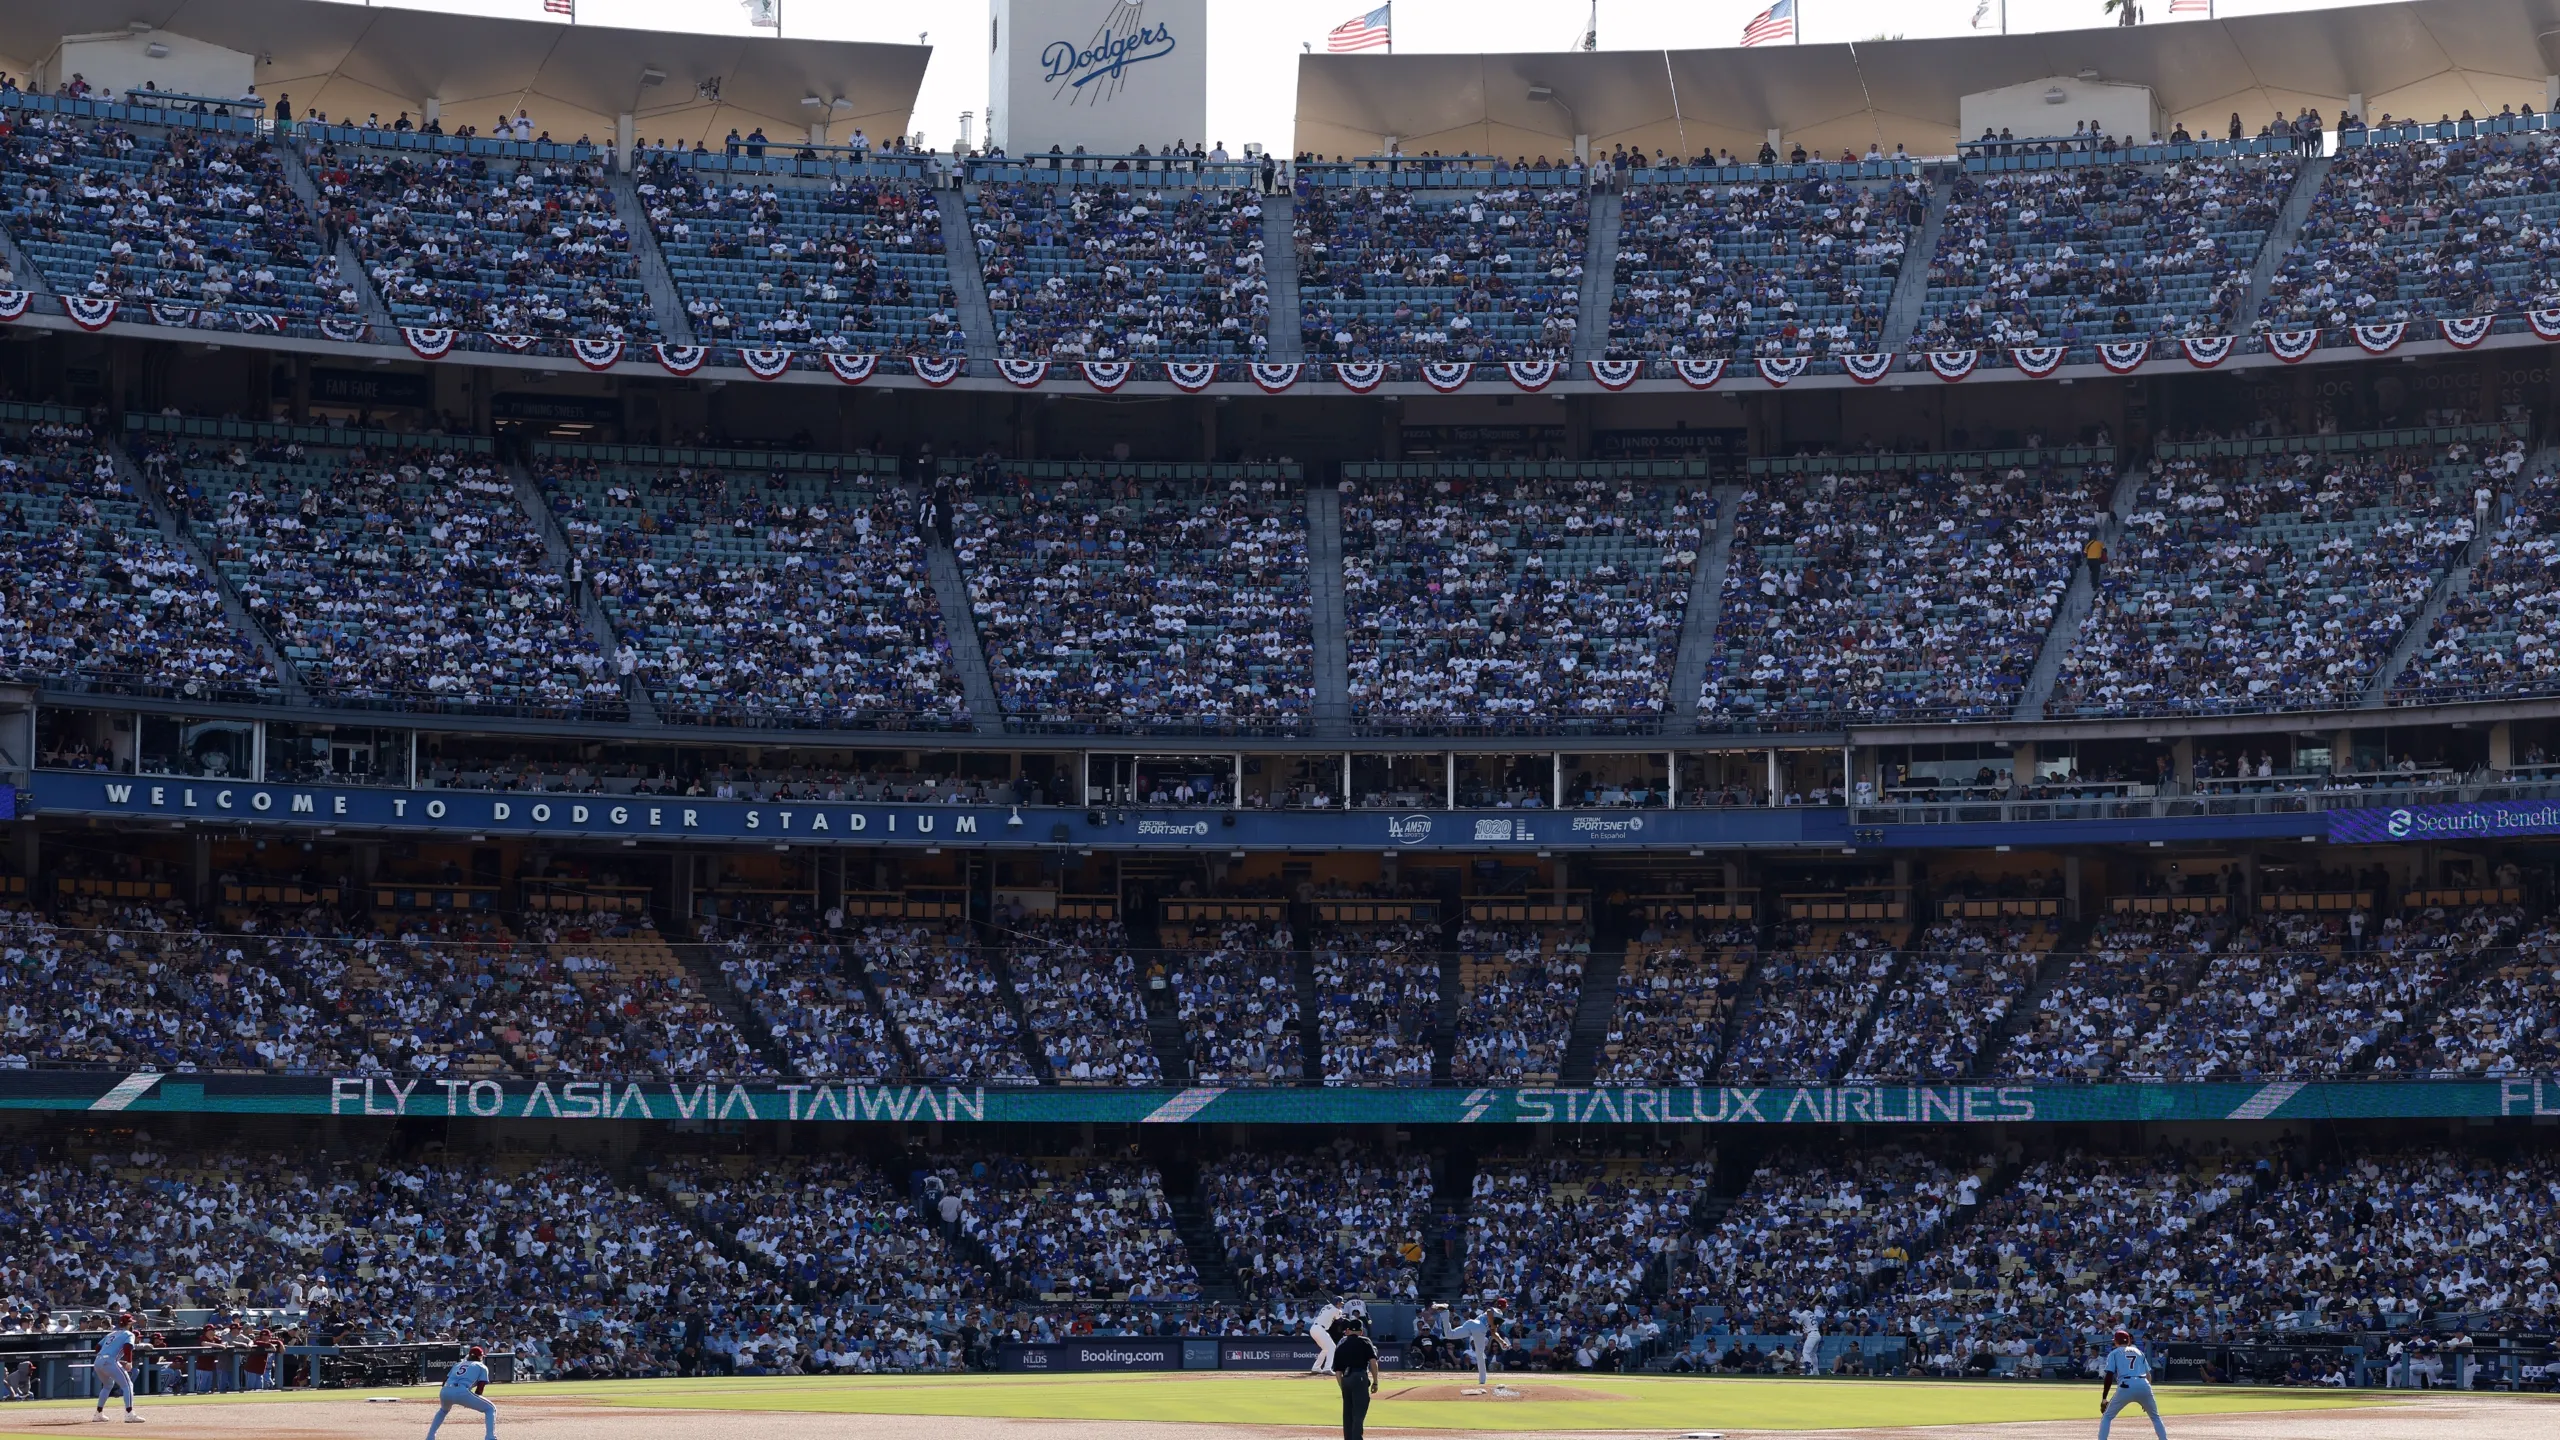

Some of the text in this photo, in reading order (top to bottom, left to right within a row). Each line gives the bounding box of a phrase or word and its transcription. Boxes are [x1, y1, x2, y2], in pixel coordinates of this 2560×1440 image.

[1041, 22, 1176, 88] Dodgers
[325, 378, 348, 397] FAN
[351, 380, 379, 398] FARE
[2411, 372, 2482, 391] DODGE
[554, 404, 585, 418] SWEETS
[1402, 429, 1432, 439] PIZZA
[1544, 428, 1566, 438] PIZZ
[1621, 436, 1659, 449] JINRO
[1663, 436, 1694, 448] SOJU
[1697, 435, 1723, 447] BAR
[105, 784, 978, 834] WELCOME TO DODGER STADIUM
[1475, 819, 1512, 834] 1020
[1571, 821, 1630, 831] SPORTSNET
[2416, 806, 2559, 833] Security Benefit
[1137, 825, 1195, 835] SPORTSNET
[1388, 816, 1404, 838] LA
[1404, 821, 1432, 833] AM570
[1600, 832, 1626, 840] Español
[331, 1078, 985, 1121] FLY TO ASIA VIA TAIWAN
[2501, 1079, 2560, 1116] FL
[1515, 1087, 2036, 1123] STARLUX AIRLINES
[105, 1335, 115, 1346] 3
[1023, 1355, 1048, 1364] NLDS
[1080, 1349, 1164, 1364] Booking.com
[1243, 1351, 1270, 1360] NLDS
[1293, 1351, 1319, 1360] Booking
[1377, 1355, 1399, 1363] .com
[2126, 1355, 2137, 1370] 7
[2169, 1356, 2206, 1367] Booking.com
[456, 1364, 469, 1376] 5
